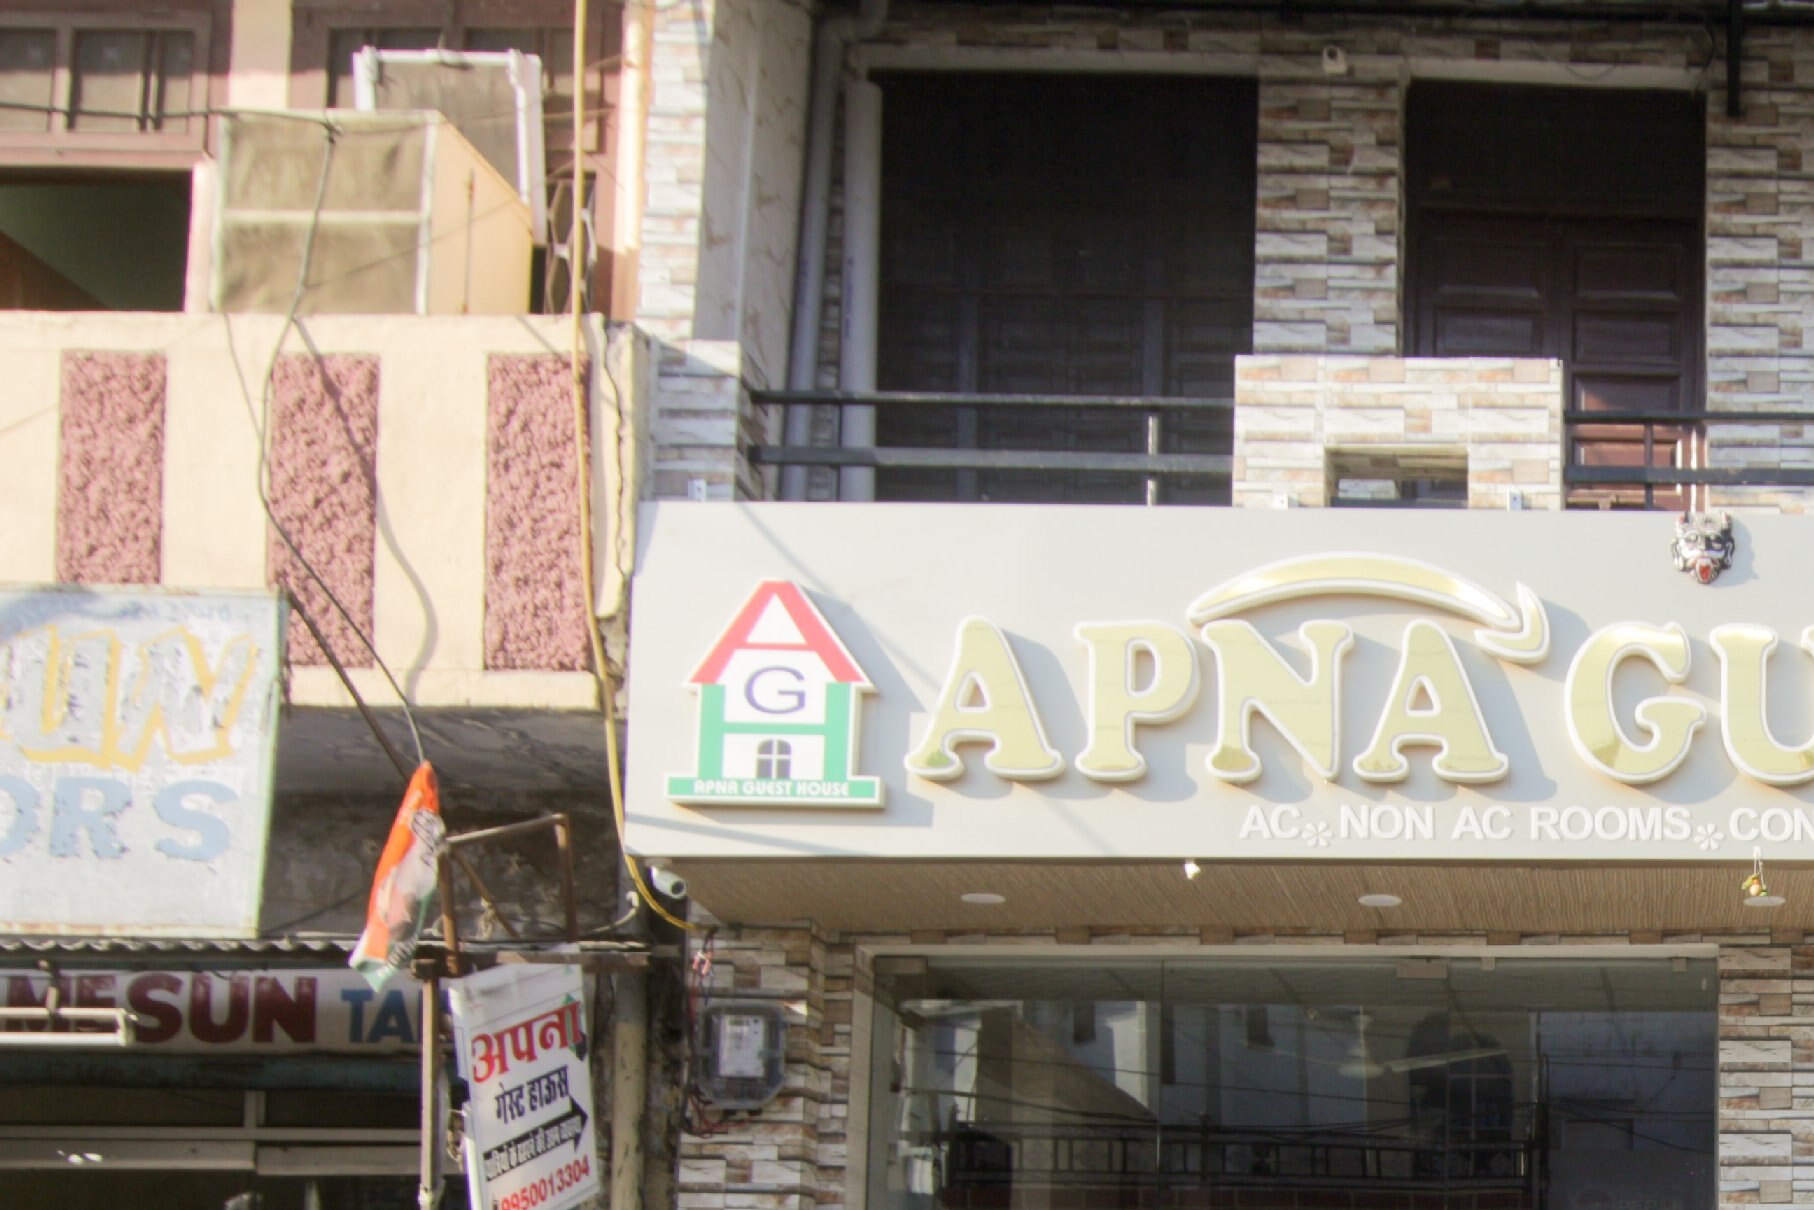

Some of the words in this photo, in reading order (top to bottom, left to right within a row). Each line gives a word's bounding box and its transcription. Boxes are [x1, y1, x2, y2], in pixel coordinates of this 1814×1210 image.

[903, 614, 1510, 786] APNA
[694, 780, 738, 795] APNA
[742, 780, 793, 795] GUEST
[796, 781, 850, 796] HOUSE
[1239, 804, 1302, 840] AC
[1339, 805, 1434, 841] NON
[1452, 805, 1512, 841] AC
[1530, 805, 1692, 842] ROOMS
[471, 1000, 583, 1083] अपना
[495, 1083, 524, 1124] गेस्ट
[527, 1065, 569, 1112] हाऊस
